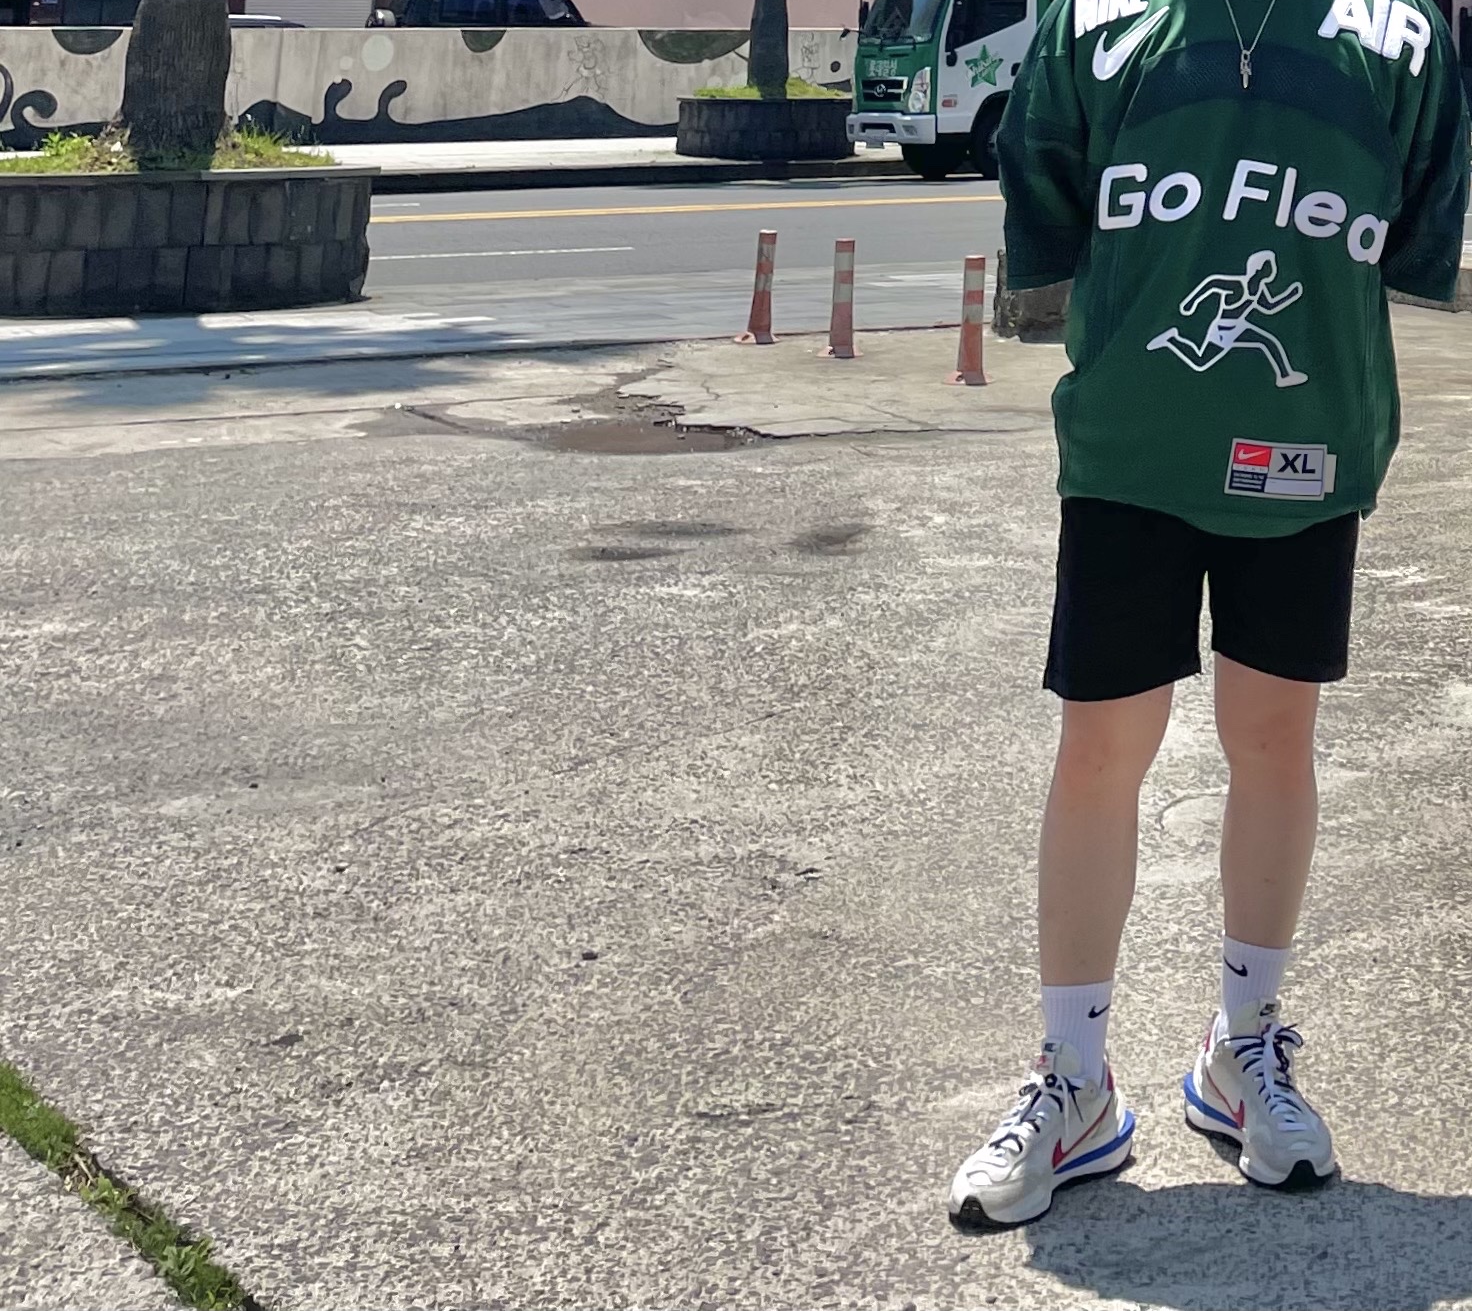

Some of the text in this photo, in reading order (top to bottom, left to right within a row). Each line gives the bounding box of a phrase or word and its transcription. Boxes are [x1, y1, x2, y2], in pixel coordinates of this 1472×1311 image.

[1099, 159, 1389, 265] Go Flea
[1277, 452, 1316, 474] XL
